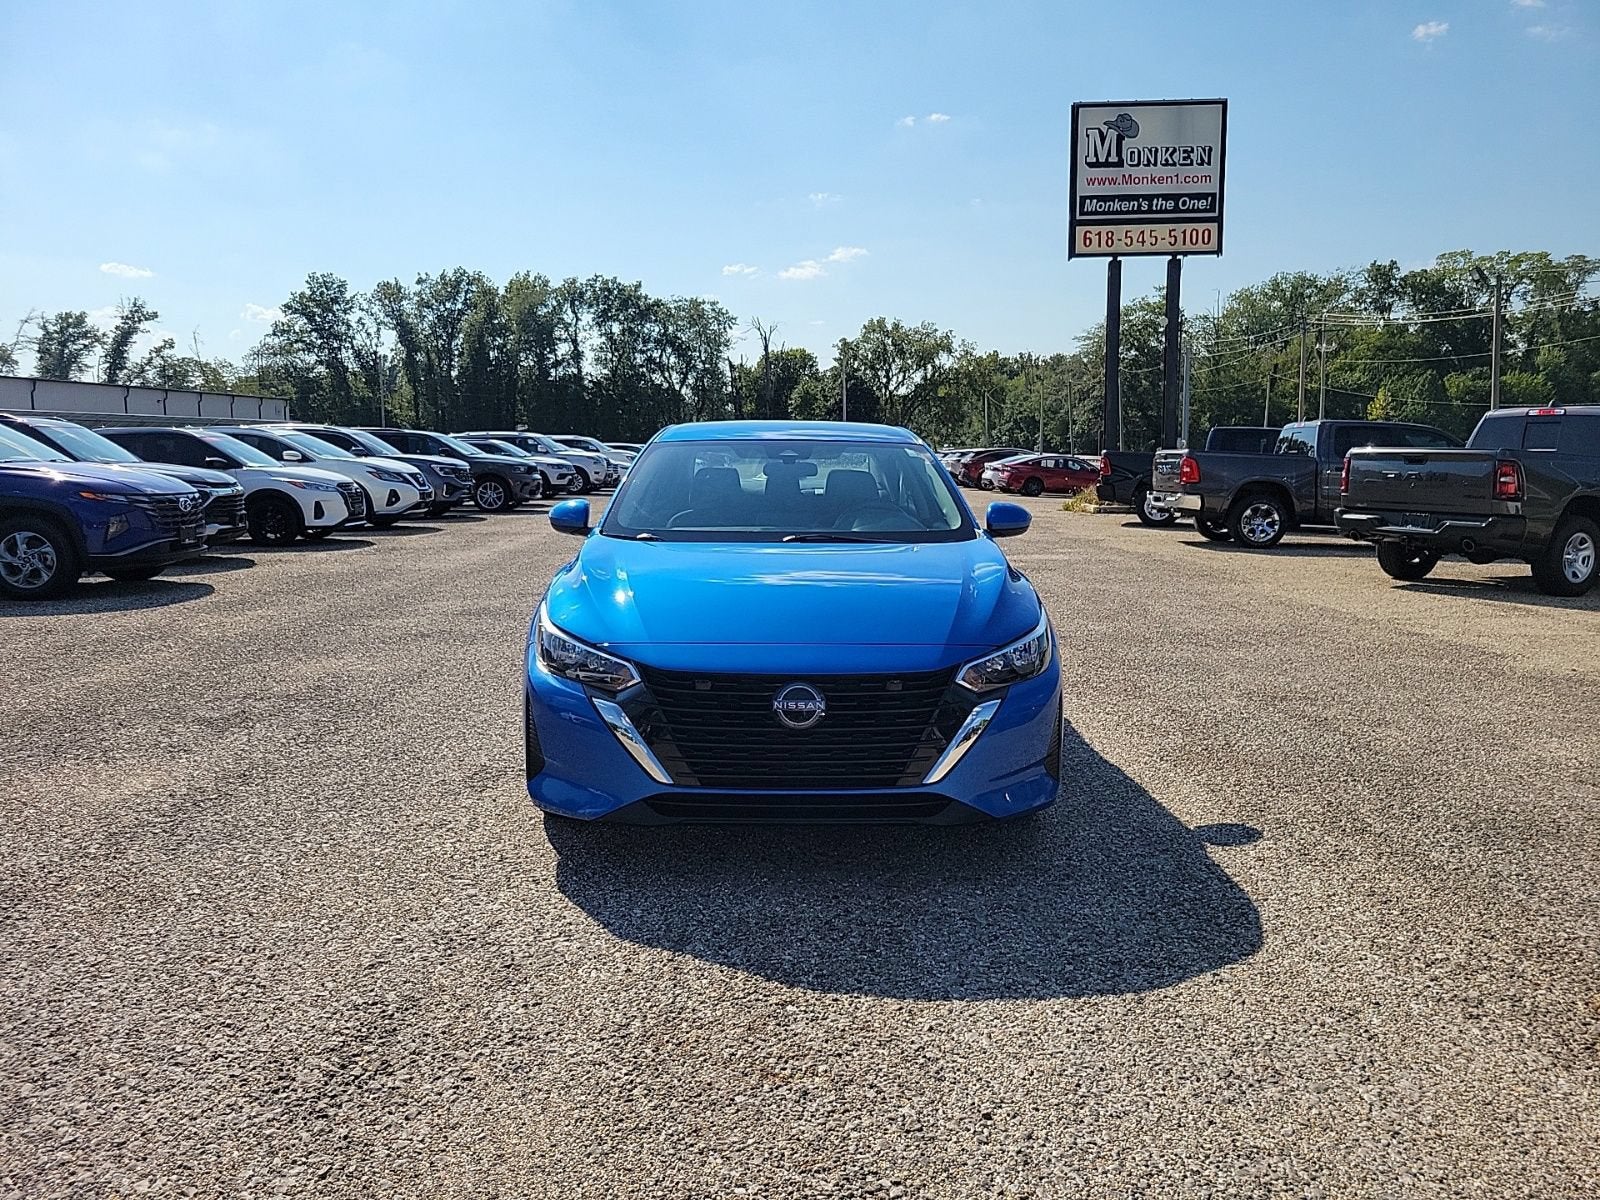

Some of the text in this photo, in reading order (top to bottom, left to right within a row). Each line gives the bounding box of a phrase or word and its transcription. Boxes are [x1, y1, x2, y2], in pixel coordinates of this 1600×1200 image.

[1084, 127, 1213, 168] MONKEN
[1086, 173, 1212, 186] www.Monken1.com
[1084, 196, 1211, 212] Monken's the One!
[1082, 227, 1212, 248] 618-545-5100
[773, 701, 826, 710] NISSAN
